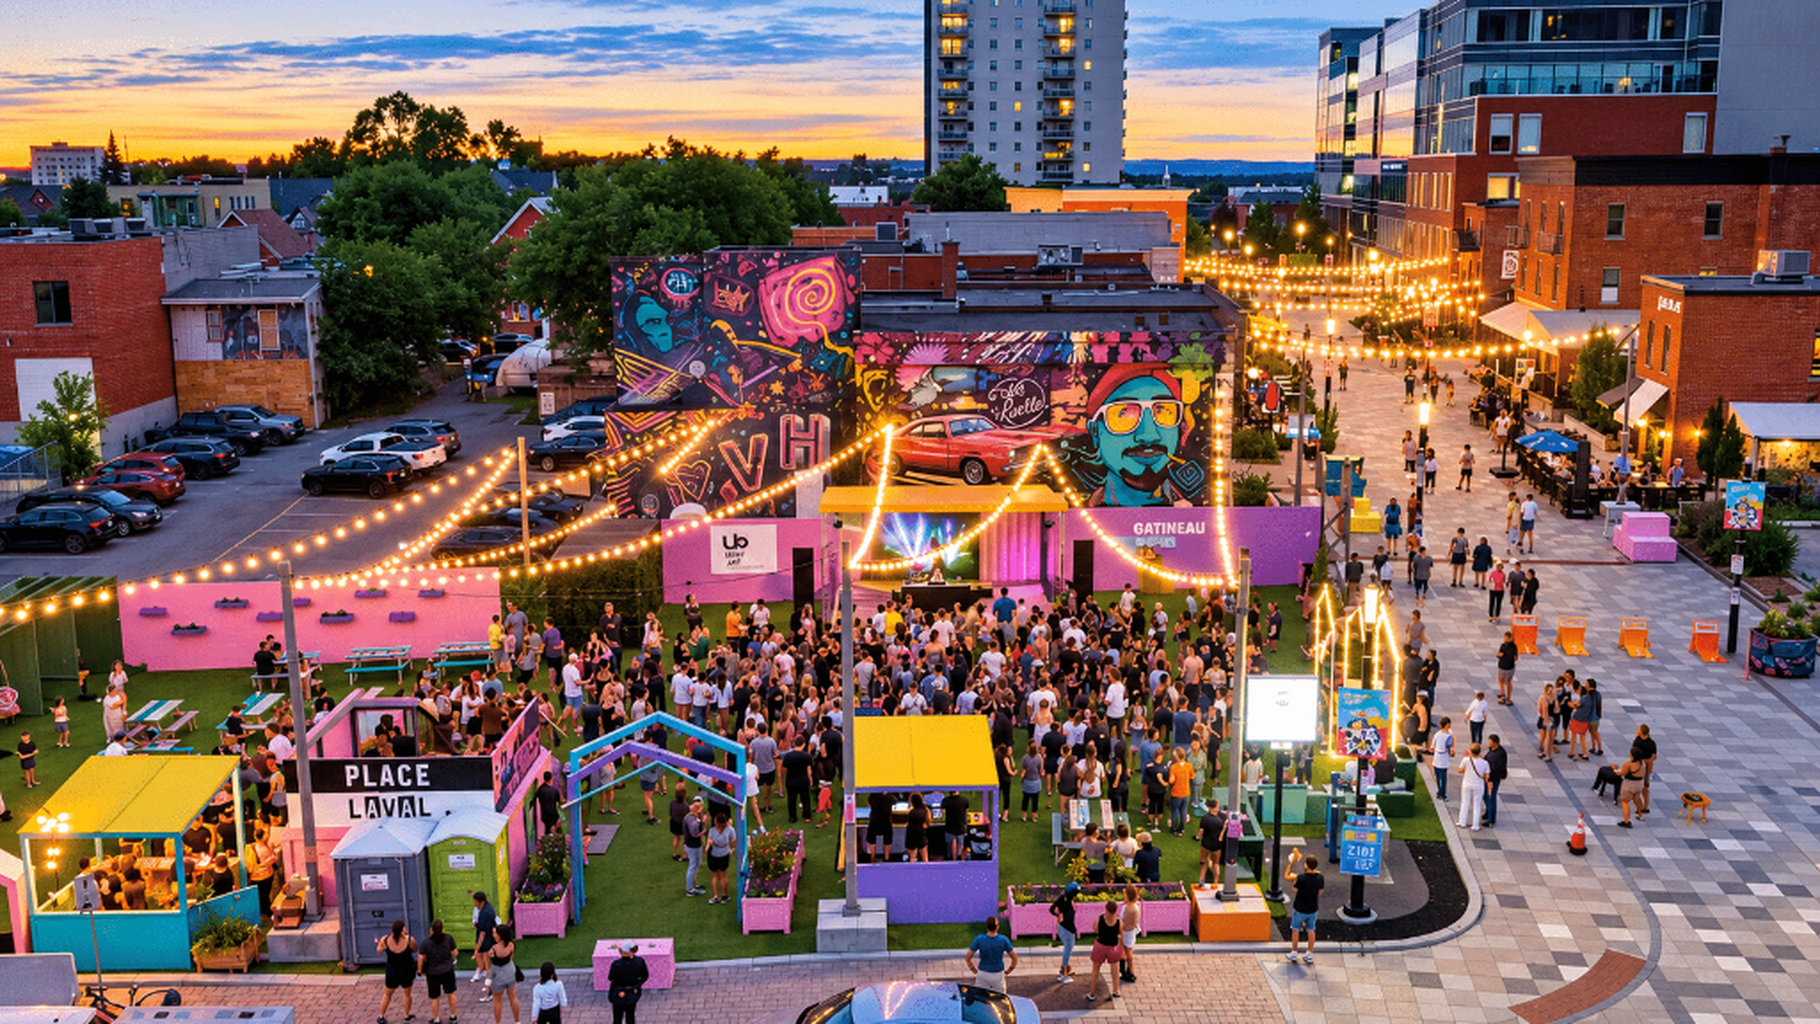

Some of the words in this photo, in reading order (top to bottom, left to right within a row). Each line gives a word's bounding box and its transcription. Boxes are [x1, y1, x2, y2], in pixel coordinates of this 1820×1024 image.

[1133, 522, 1206, 535] GATINEAU
[344, 764, 431, 787] PLACE
[348, 796, 432, 819] LAVAL
